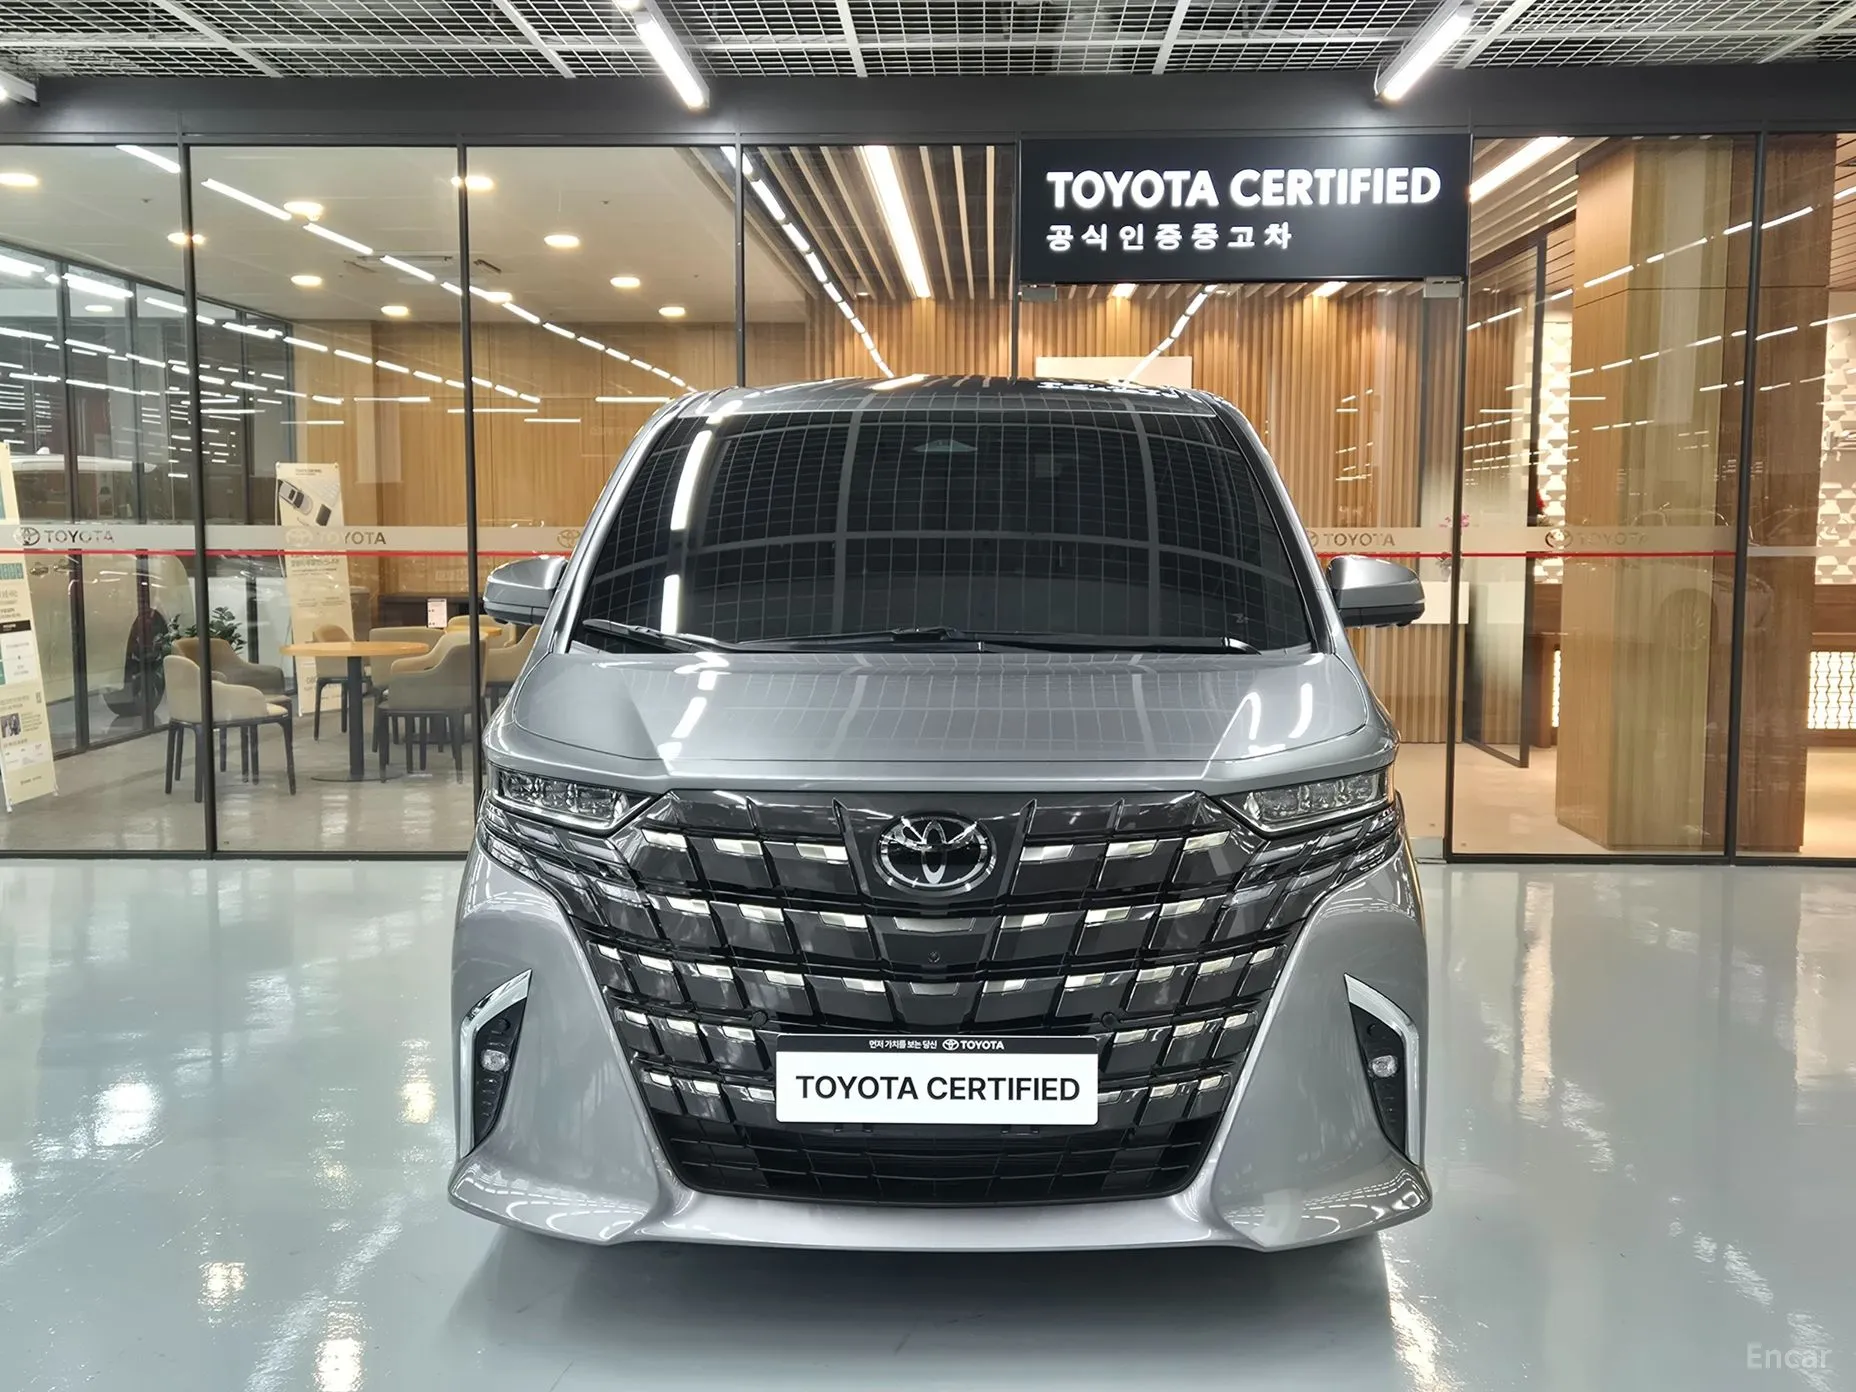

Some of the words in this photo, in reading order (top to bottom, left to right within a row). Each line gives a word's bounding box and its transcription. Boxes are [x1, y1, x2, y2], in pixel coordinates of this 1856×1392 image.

[1046, 169, 1220, 209] TOYOTA
[1229, 165, 1442, 208] CERTIFIED
[44, 529, 115, 544] TOYOTA
[1323, 532, 1396, 547] TOYOTA
[869, 1039, 884, 1049] 먼저
[884, 1039, 906, 1049] 가치를
[907, 1039, 922, 1049] 보는
[922, 1039, 937, 1050] 당신
[960, 1040, 1005, 1050] TOYOTA
[796, 1075, 919, 1100] TOYOTA
[926, 1076, 1080, 1102] CERTIFIED
